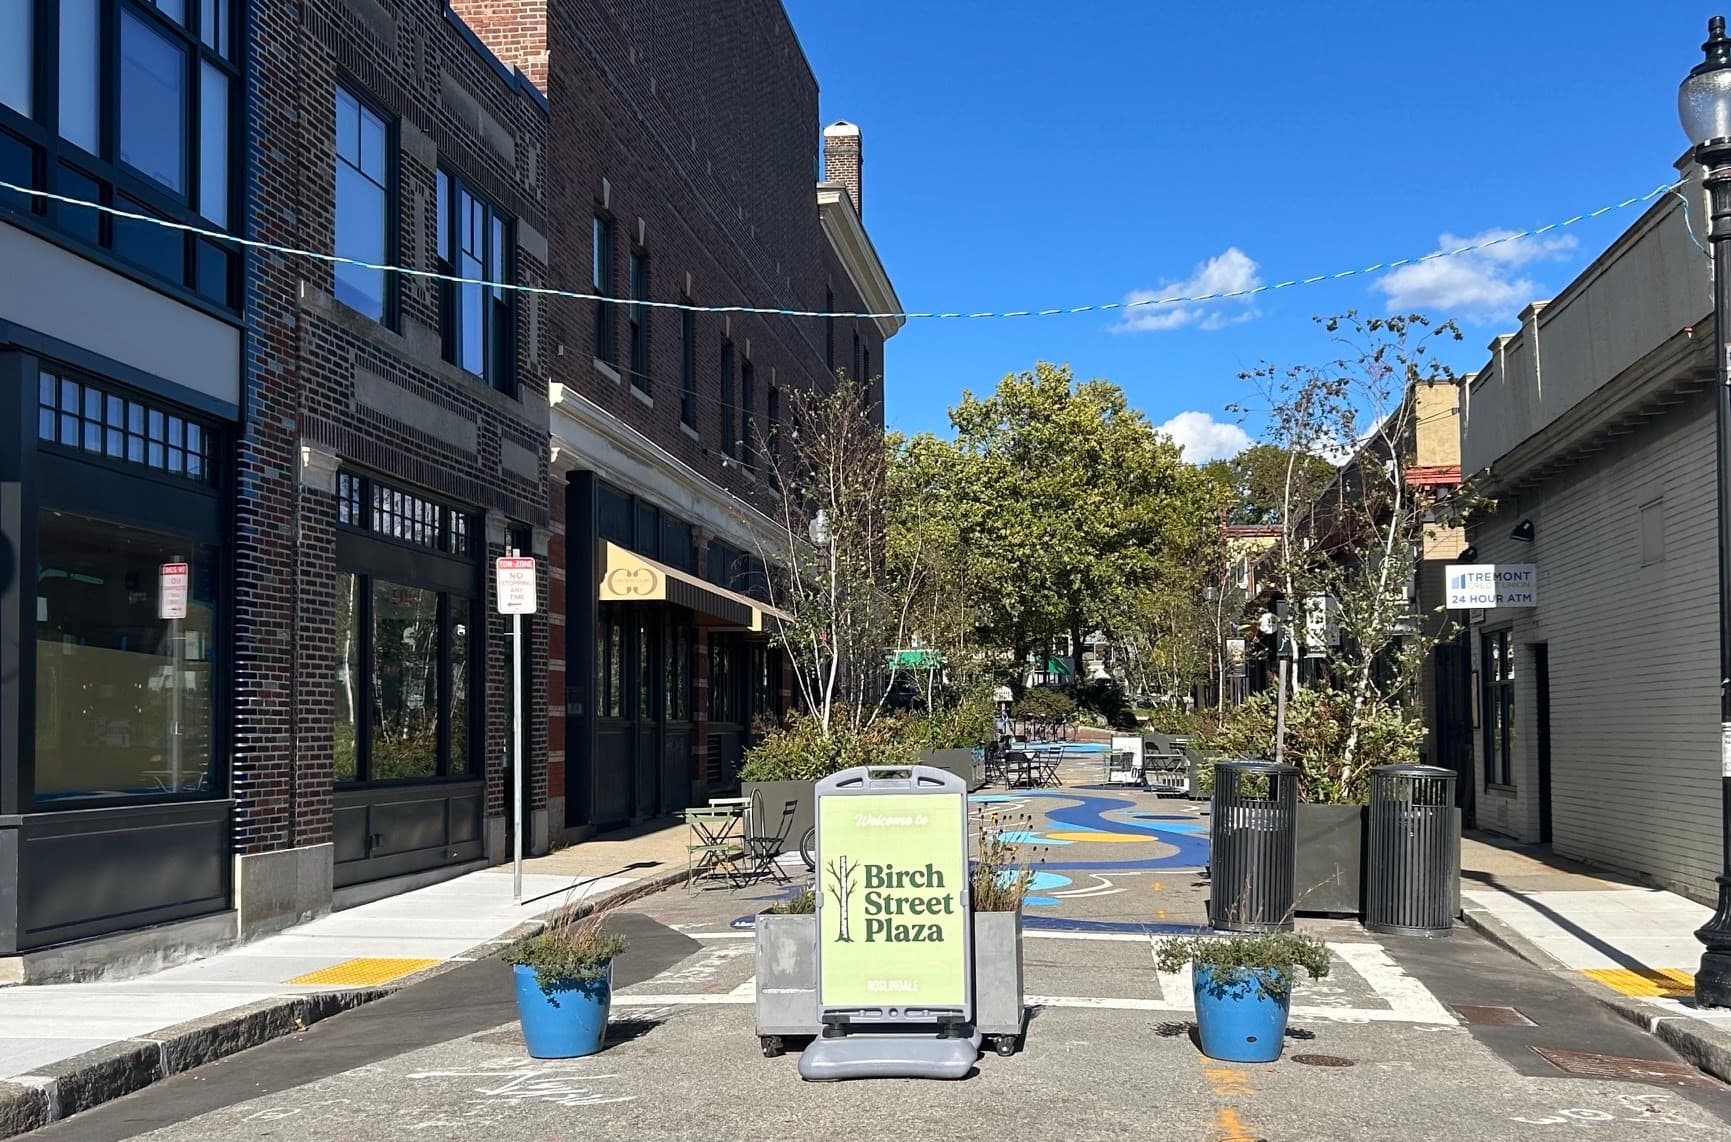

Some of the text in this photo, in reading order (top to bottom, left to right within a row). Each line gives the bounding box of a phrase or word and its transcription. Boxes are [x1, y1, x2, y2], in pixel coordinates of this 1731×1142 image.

[1467, 572, 1531, 581] TREMONT
[1452, 594, 1532, 603] 24 HOUR ATM
[855, 813, 928, 827] Welcome to
[864, 863, 945, 889] Birch
[864, 891, 954, 916] Street
[864, 917, 944, 943] Plaza
[868, 979, 920, 991] ROSLINDALE
